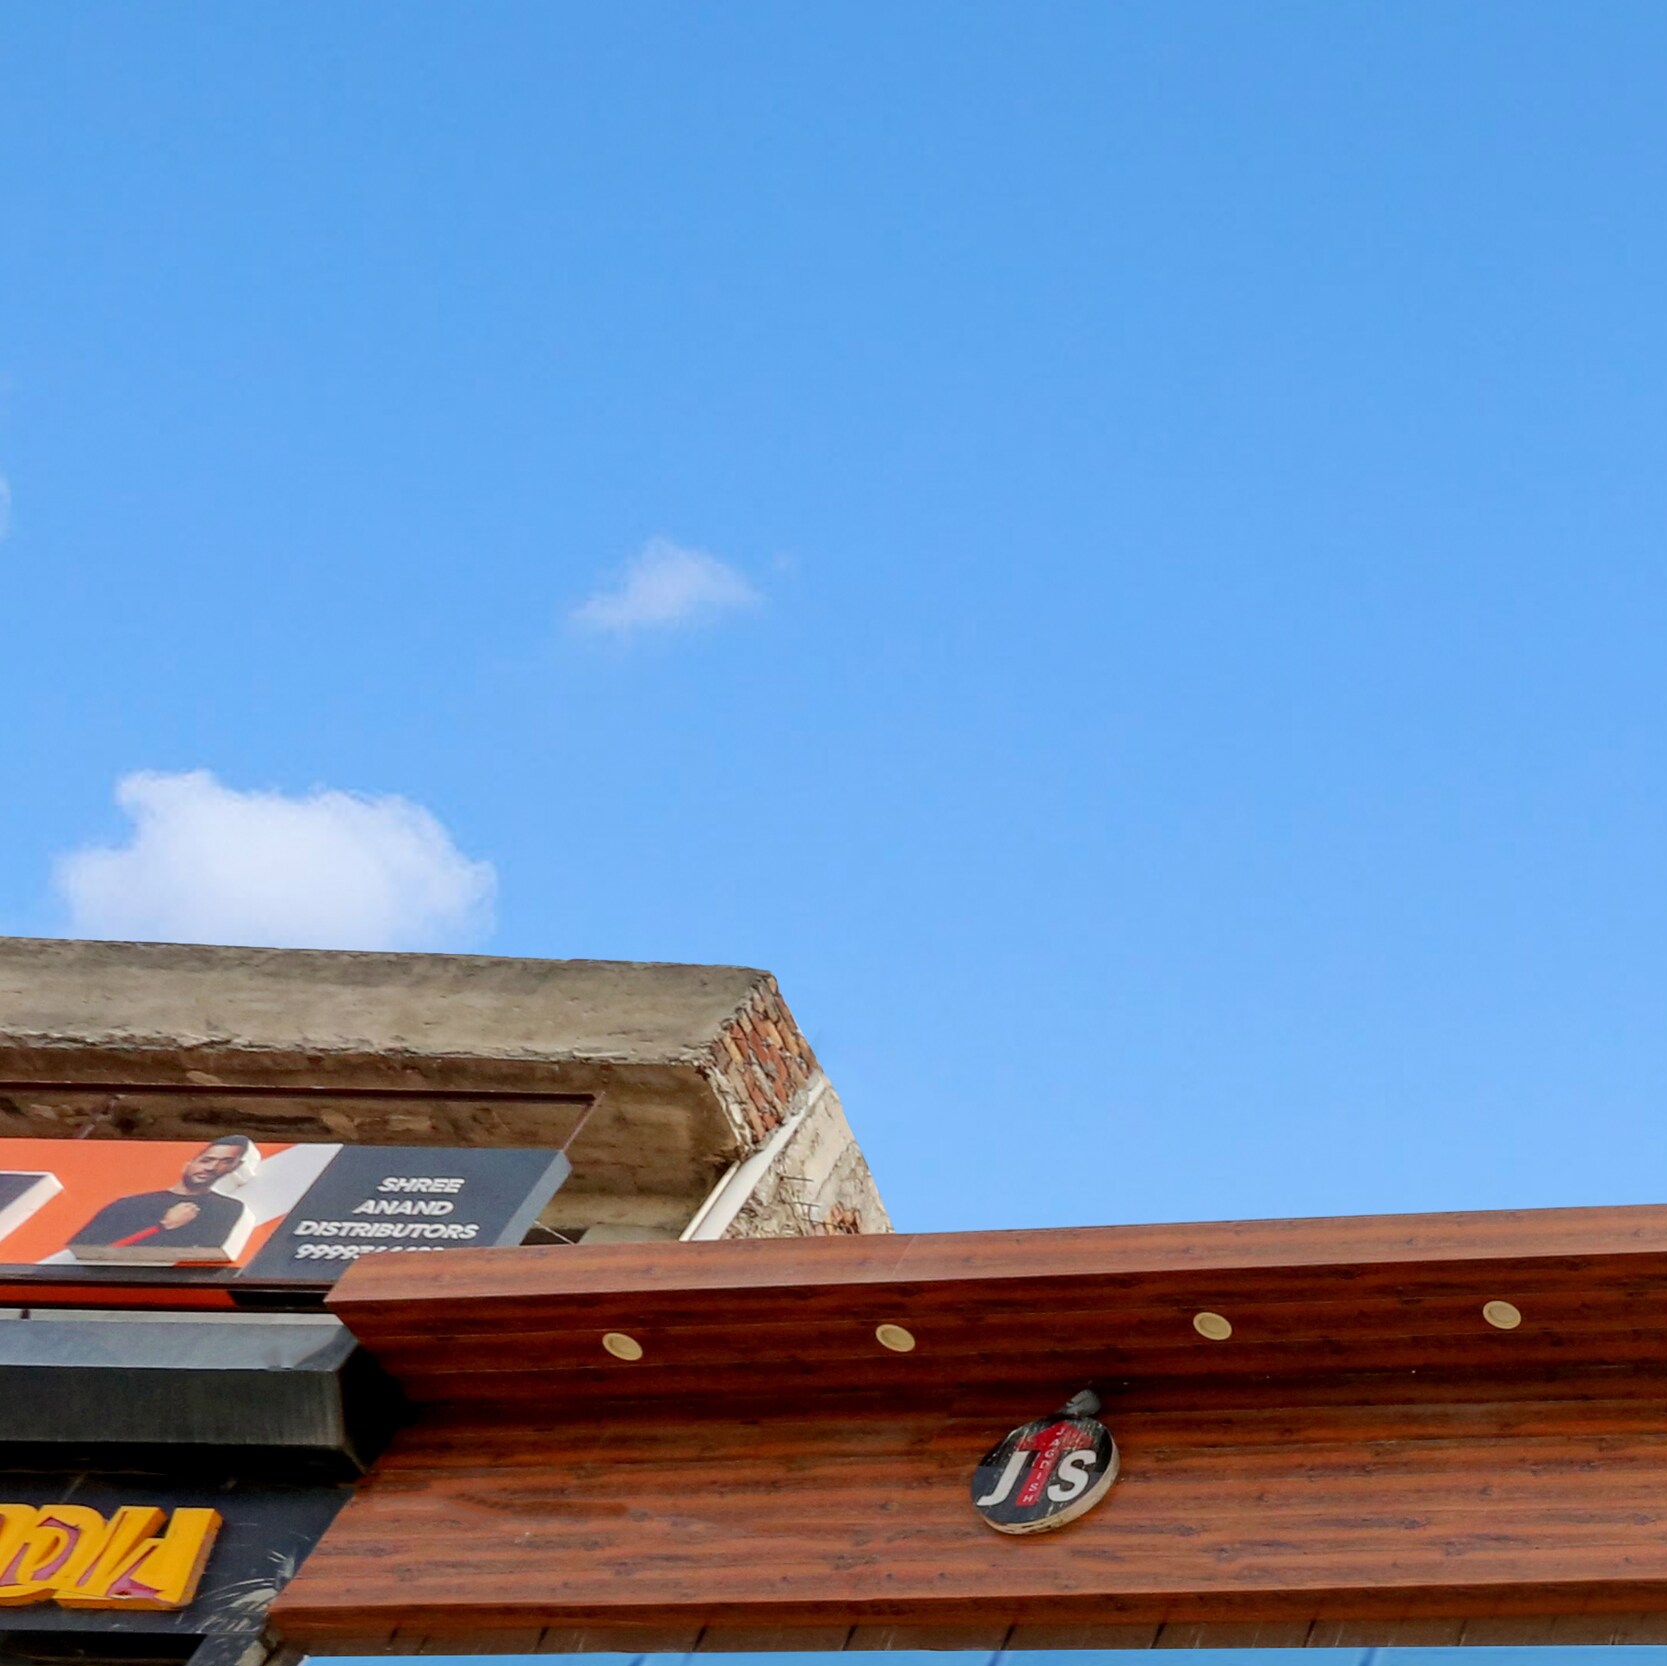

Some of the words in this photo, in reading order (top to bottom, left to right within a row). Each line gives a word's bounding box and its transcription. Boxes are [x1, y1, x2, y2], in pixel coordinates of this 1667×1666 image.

[376, 1176, 466, 1194] SHREE
[351, 1199, 455, 1216] ANAND
[292, 1220, 480, 1240] DISTRIBUTORS
